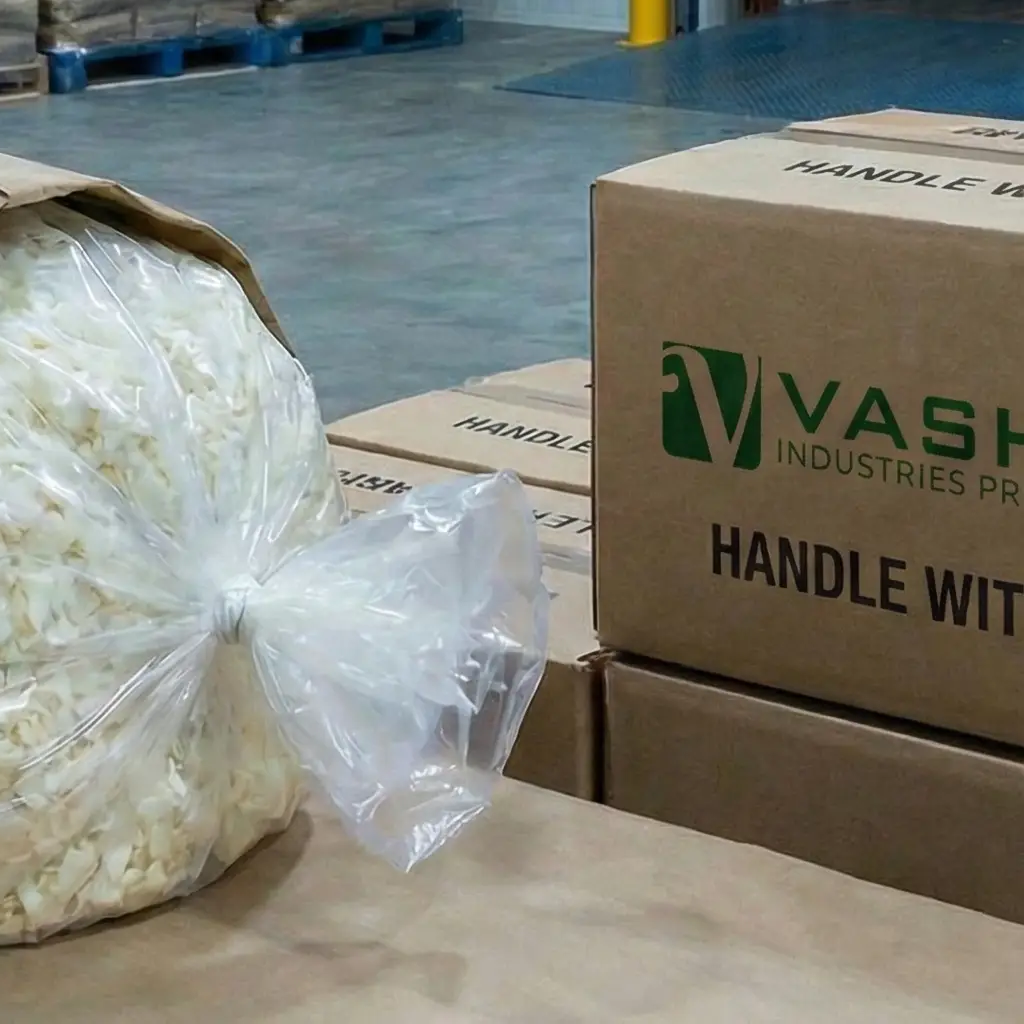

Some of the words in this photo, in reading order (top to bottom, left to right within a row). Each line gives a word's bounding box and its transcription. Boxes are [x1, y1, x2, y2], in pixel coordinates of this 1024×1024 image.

[784, 160, 987, 192] HANDLE
[453, 416, 593, 454] HANDLE
[778, 438, 966, 496] INDUSTRIES
[712, 523, 908, 614] HANDLE
[925, 565, 1024, 636] WIT
